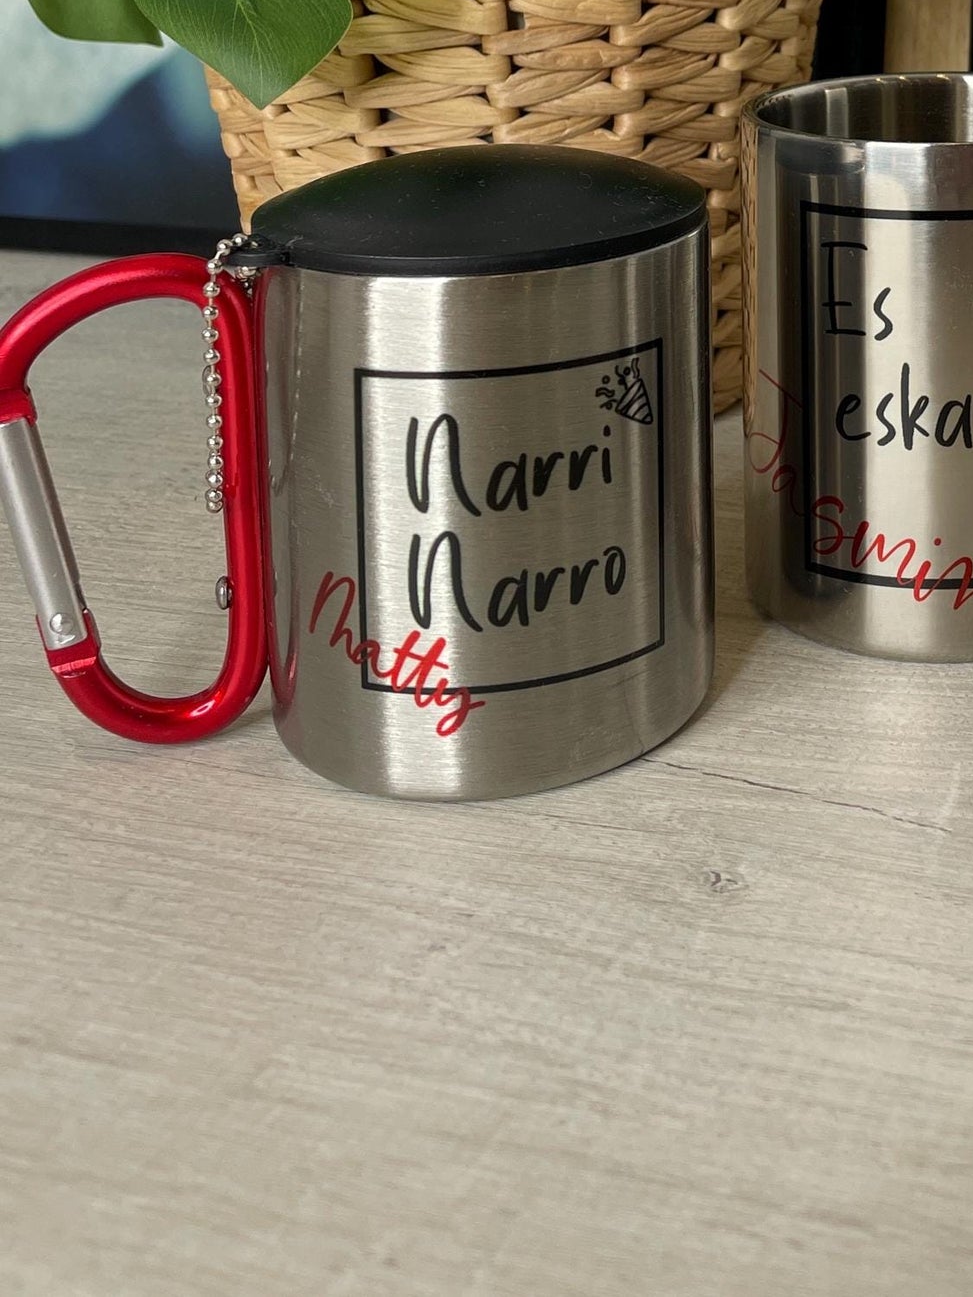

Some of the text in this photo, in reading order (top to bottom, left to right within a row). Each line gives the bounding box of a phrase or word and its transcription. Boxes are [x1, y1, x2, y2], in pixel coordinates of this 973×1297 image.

[820, 240, 894, 342] Es
[405, 413, 613, 518] Narri
[407, 530, 627, 634] Narro
